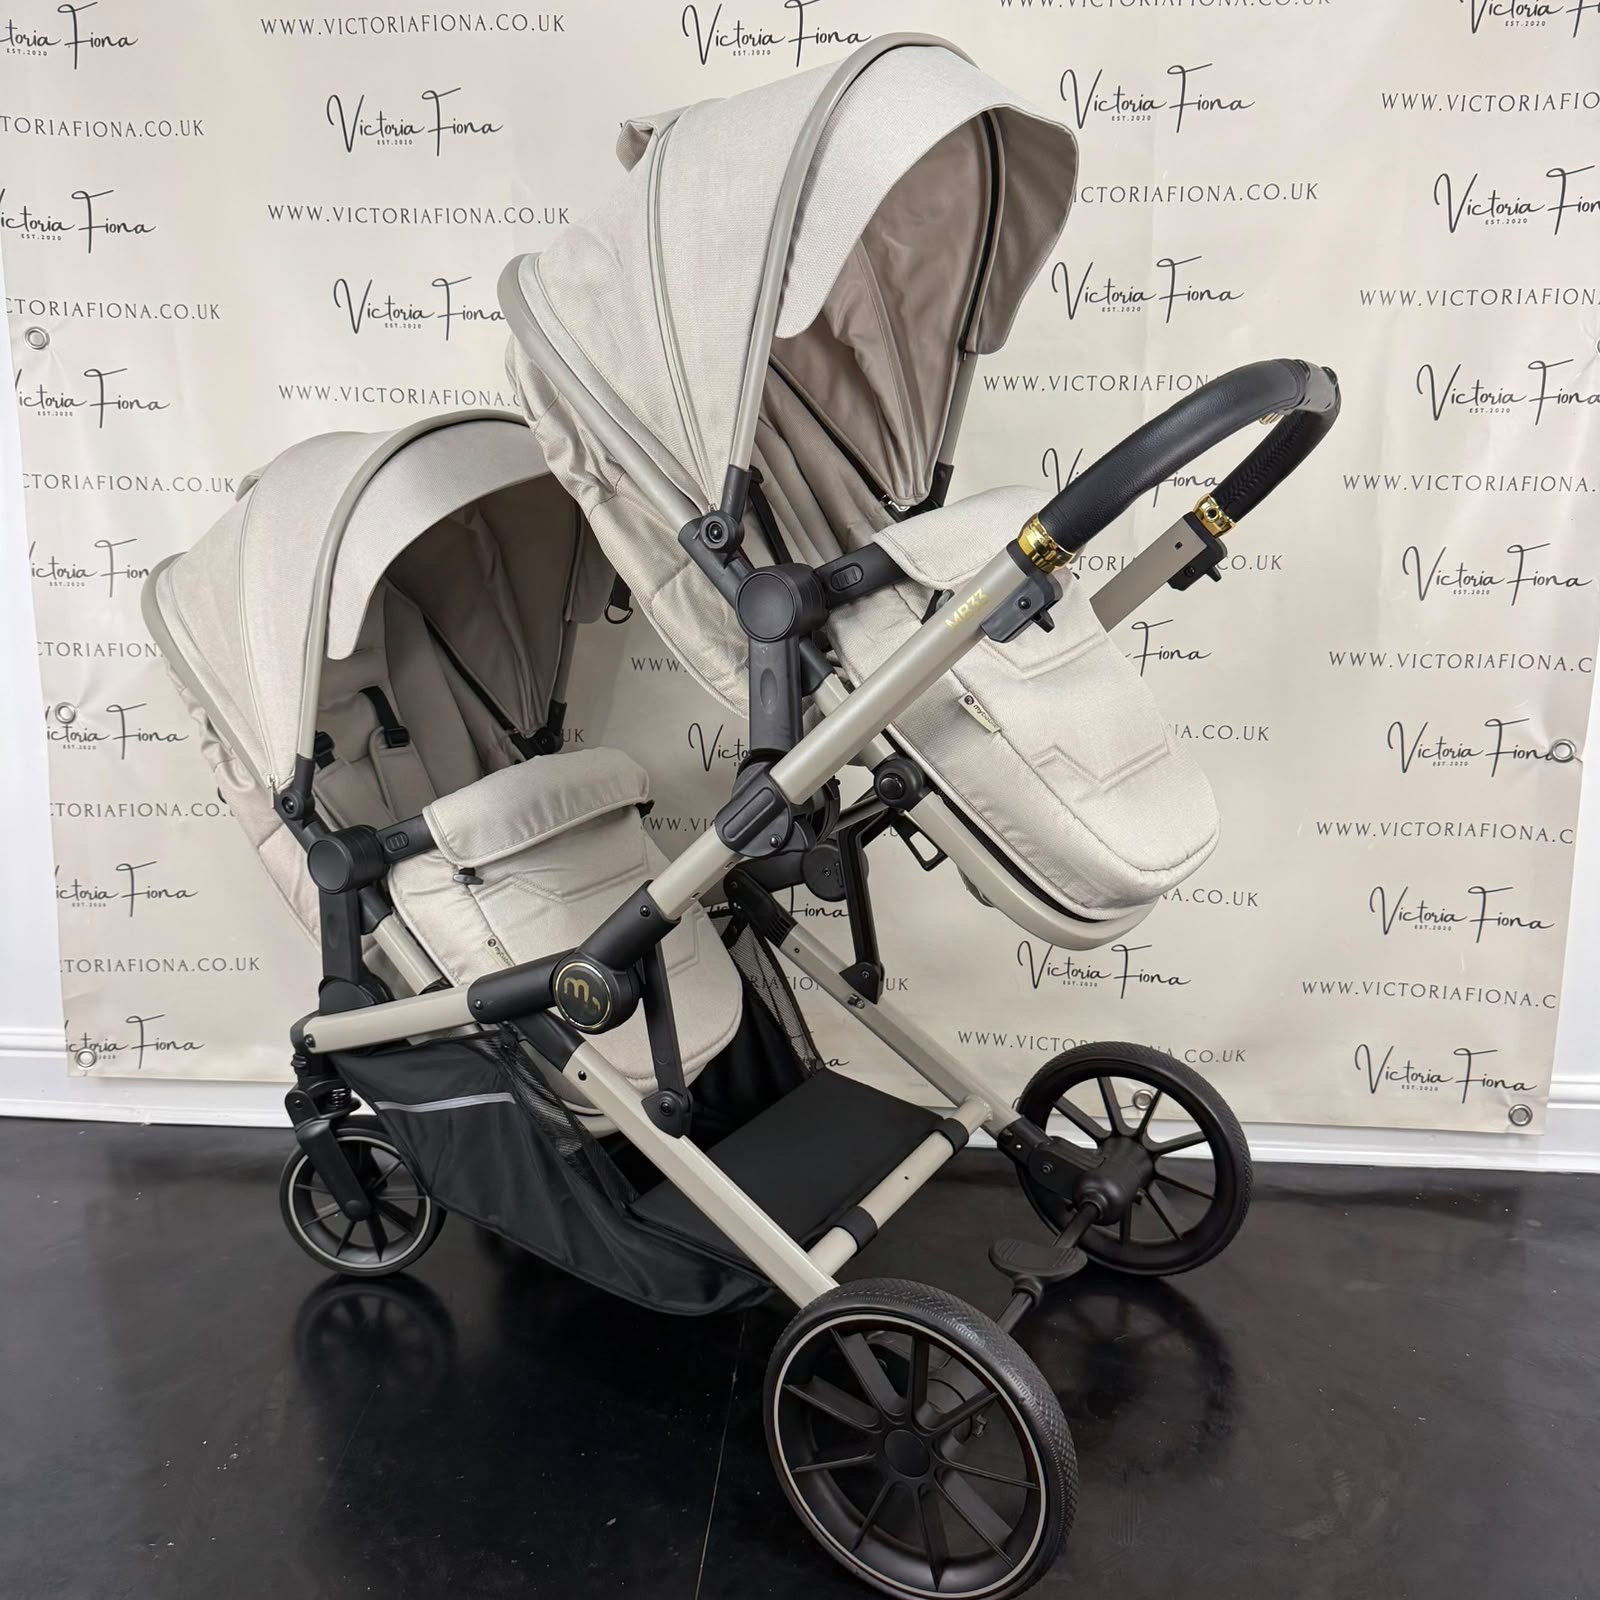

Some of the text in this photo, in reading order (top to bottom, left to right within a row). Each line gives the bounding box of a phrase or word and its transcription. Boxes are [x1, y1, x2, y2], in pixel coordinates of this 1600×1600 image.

[0, 1, 139, 70] toria Fiona
[260, 13, 566, 35] WWW.VICTORIAFIONA.CO.UK
[681, 0, 872, 67] Victoria Fiona
[1505, 19, 1547, 28] EST.2020
[6, 47, 49, 57] EST.2020
[733, 49, 772, 57] EST.2020
[1060, 63, 1255, 133] Victoria Fiona
[1381, 91, 1600, 112] WWW.VICTORIAFIO
[0, 115, 205, 138] TORIAFIONA.CO.UK
[326, 87, 504, 157] Victoria Fiona
[1111, 114, 1153, 122] EST.2020
[377, 138, 414, 146] EST.2020
[1073, 182, 1319, 203] ICTORIAFIONA.CO.UK
[1433, 165, 1600, 236] Victoria Fion
[0, 188, 156, 253] ictoria Fiona
[267, 204, 571, 224] WWW.VICTORIAFIONA.CO.UK
[1485, 217, 1529, 226] EST.2020
[21, 232, 63, 242] EST.2020
[1051, 255, 1245, 324] Victoria Fiona
[1359, 288, 1600, 307] WWW.VICTORIAFION
[333, 276, 505, 341] Victoria Fiona
[1102, 305, 1142, 314] EST.2020
[278, 384, 521, 407] WWW.VICTORIAFIONA.
[984, 375, 1209, 392] WWW.VICTORIAFION
[1416, 359, 1600, 426] Victoria Fiona
[15, 368, 170, 429] ictoria Fiona
[1469, 407, 1512, 415] EST.2020
[1343, 475, 1596, 492] WWW.VICTORIAFIONA.
[29, 538, 149, 598] ictoria Fion
[1402, 543, 1593, 606] Victoria Fiona
[1453, 588, 1492, 596] EST.2020
[1131, 619, 1212, 677] Fiona
[1329, 651, 1593, 673] WWW.VICTORIAFIONA.C
[45, 703, 189, 760] ictoria Fiona
[688, 723, 749, 772] Victo
[1387, 721, 1483, 773] Victoria
[50, 802, 234, 817] TORIAFIONA.CO.
[1316, 821, 1574, 845] WWW.VICTORIAFIONA.C
[55, 861, 198, 917] ictoria Fiona
[1369, 886, 1555, 943] Victoria Fiona
[60, 957, 260, 974] TORIAFIONA.CO.UK
[1017, 940, 1191, 999] Victoria Fiona
[1302, 981, 1557, 1009] WWW.VICTORIAFIONA.C
[64, 1014, 204, 1070] ictoria Fiona
[1354, 1044, 1537, 1104] Victoria Fiona
